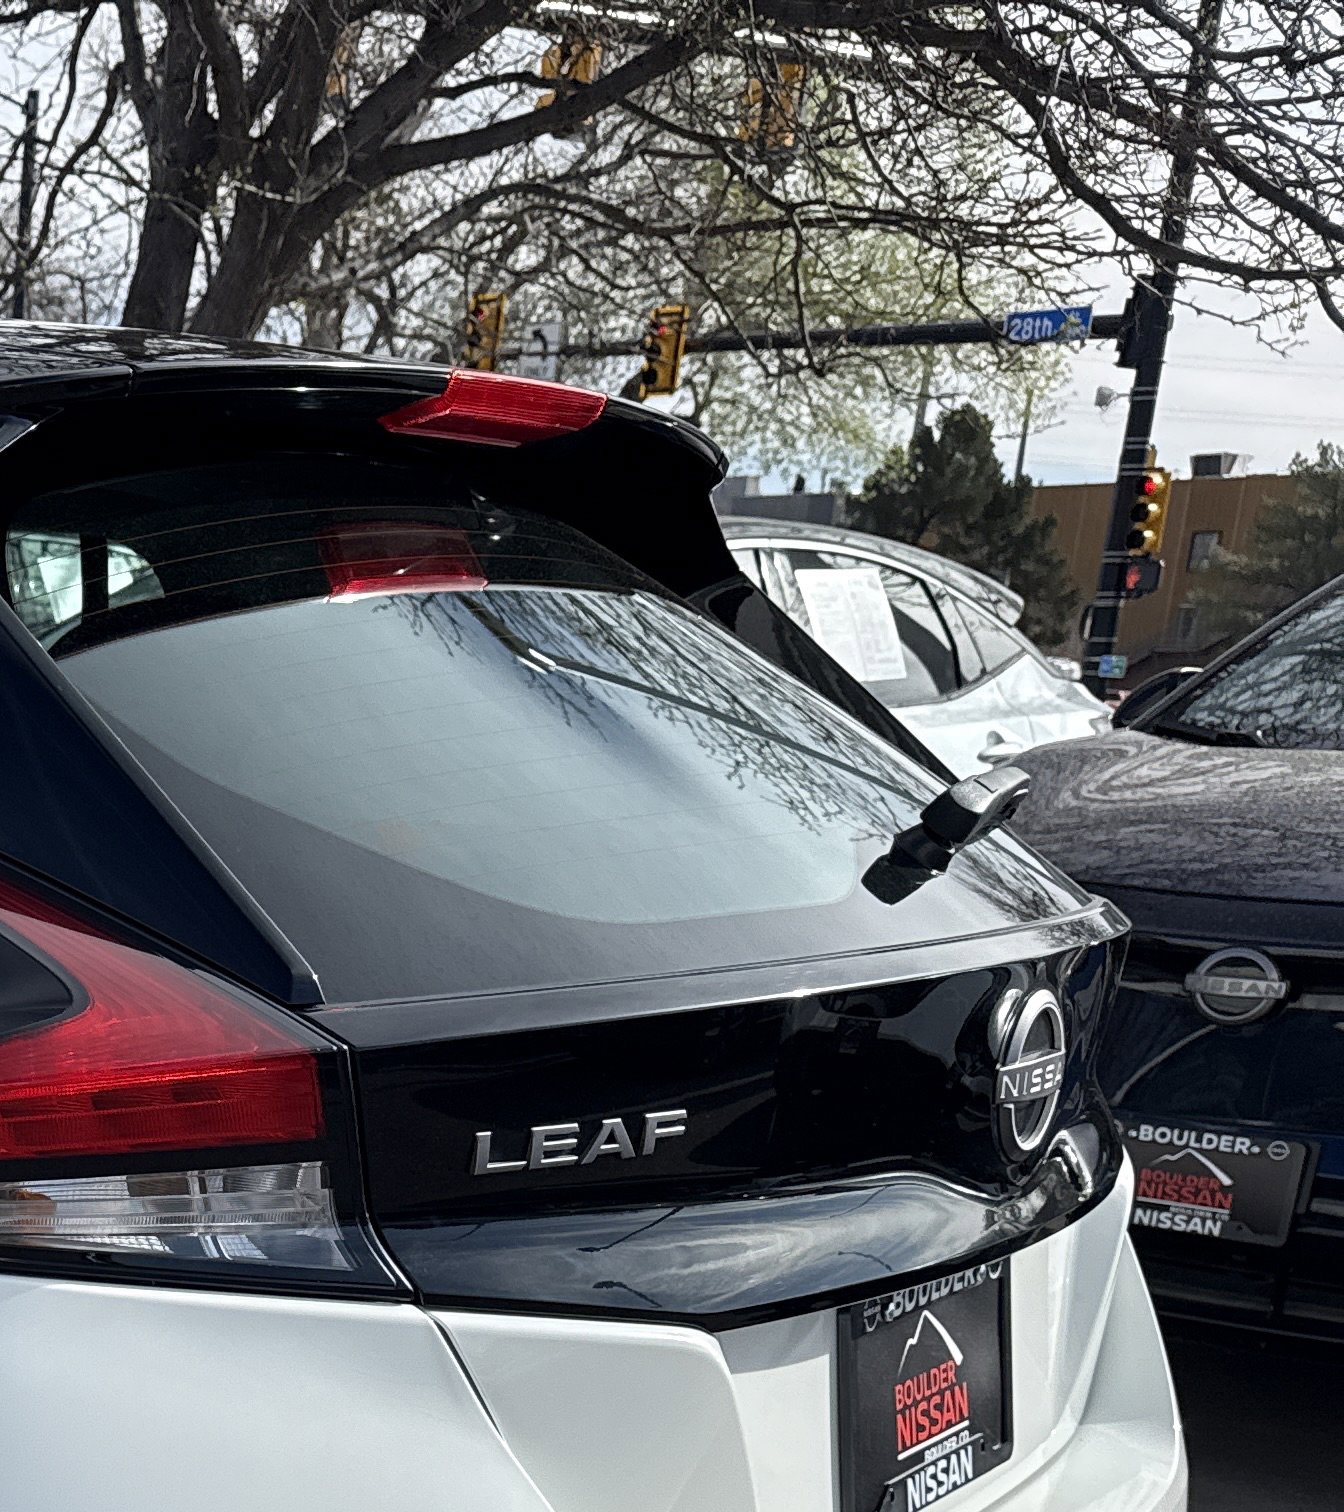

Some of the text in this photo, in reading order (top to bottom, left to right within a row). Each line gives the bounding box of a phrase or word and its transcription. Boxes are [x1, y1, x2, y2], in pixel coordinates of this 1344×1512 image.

[1009, 316, 1053, 341] 28th
[472, 1108, 688, 1176] LEAF
[1138, 1123, 1252, 1156] BOULDER
[1140, 1167, 1221, 1191] BOULDER
[1137, 1181, 1234, 1212] NISSAN
[1133, 1207, 1223, 1238] NISSAN
[894, 1359, 957, 1411] BOULDER
[895, 1381, 970, 1452] NISSAN
